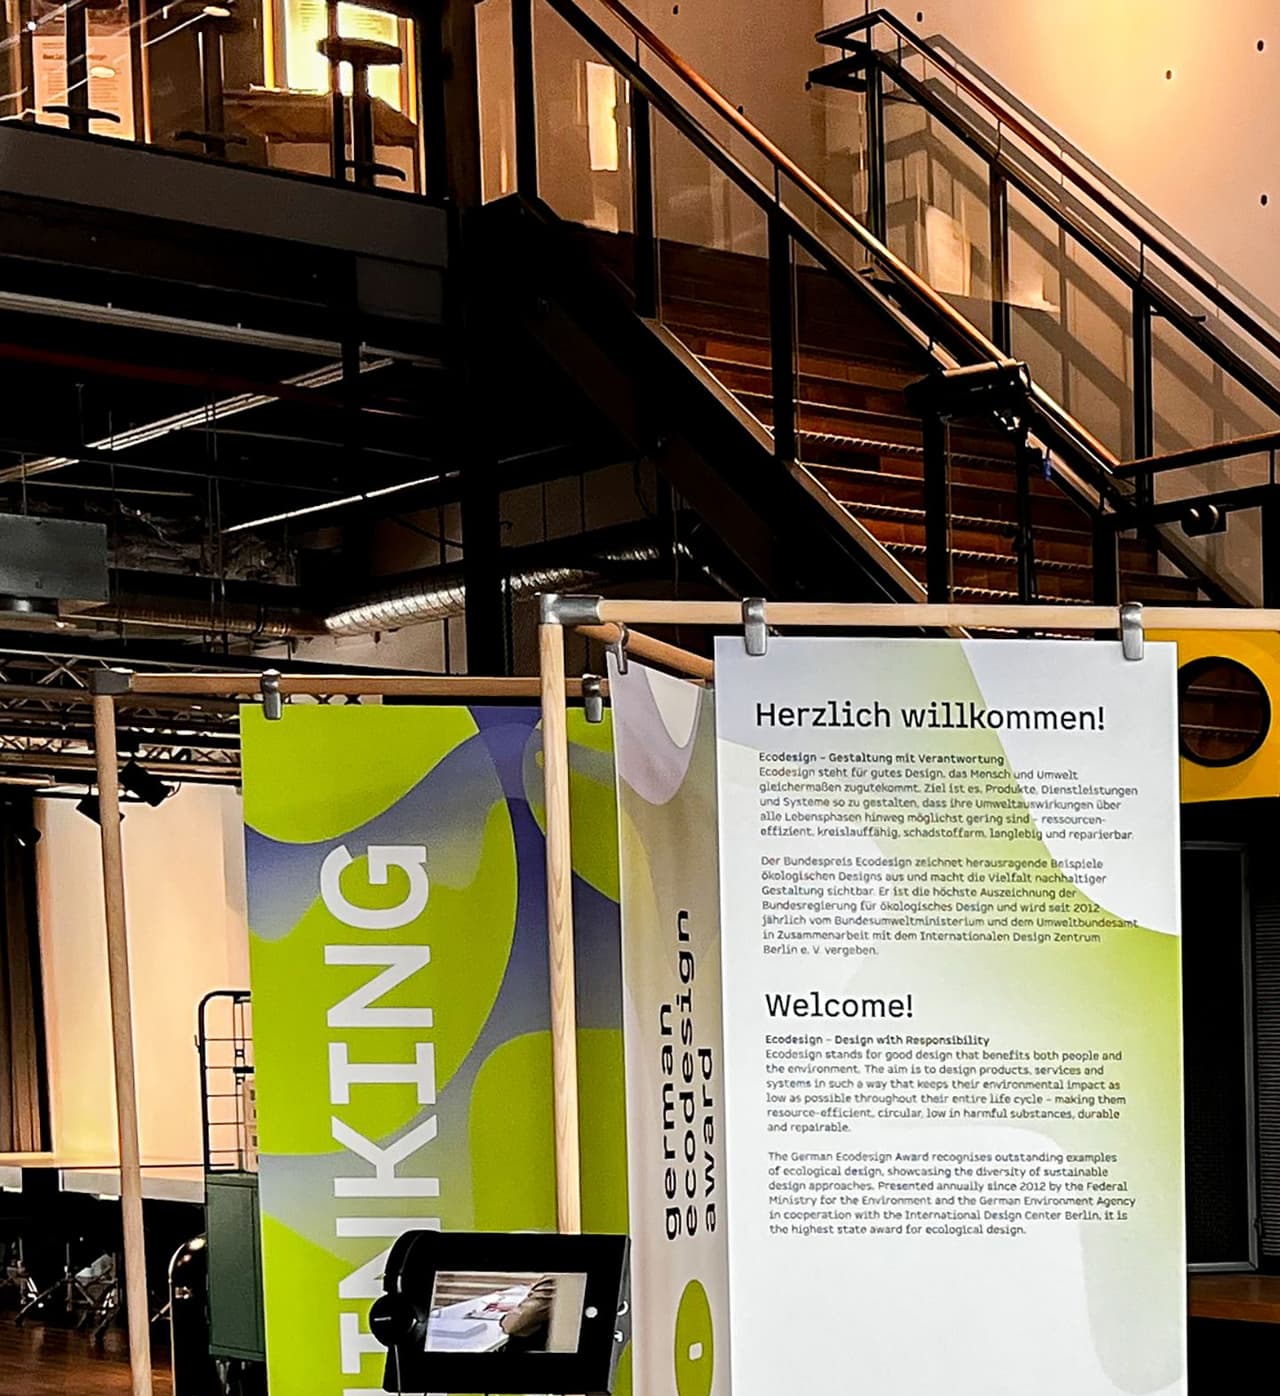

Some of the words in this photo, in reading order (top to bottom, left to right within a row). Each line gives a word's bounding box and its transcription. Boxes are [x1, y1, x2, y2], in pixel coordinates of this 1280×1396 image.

[756, 700, 890, 727] Herzlich
[901, 701, 1103, 730] willkommen!
[759, 751, 817, 765] Ecodesign
[895, 752, 915, 763] mit
[759, 767, 815, 781] Ecodesign
[817, 767, 848, 778] steht
[851, 767, 868, 778] für
[870, 768, 902, 781] gutes
[948, 768, 967, 779] das
[970, 768, 1011, 779] Mensch
[1012, 769, 1033, 779] und
[1036, 769, 1078, 780] Umwelt
[924, 783, 946, 793] Ziel
[949, 783, 965, 794] ist
[765, 991, 912, 1017] Welcome!
[765, 1033, 823, 1047] Ecodesign
[834, 1034, 873, 1047] Design
[876, 1034, 903, 1045] with
[765, 1049, 822, 1062] Ecodesign
[825, 1049, 863, 1060] stands
[865, 1049, 882, 1060] for
[885, 1049, 913, 1062] good
[915, 1049, 952, 1063] design
[955, 1049, 979, 1060] that
[982, 1049, 1030, 1060] benefits
[1033, 1050, 1059, 1060] both
[1061, 1050, 1099, 1063] people
[1101, 1050, 1122, 1061] and
[676, 910, 698, 1237] ecodesign
[765, 1063, 785, 1074] the
[864, 1064, 884, 1075] The
[887, 1064, 908, 1075] aim
[910, 1064, 921, 1075] is
[923, 1064, 936, 1075] to
[938, 1064, 976, 1078] design
[1034, 1065, 1081, 1075] services
[1083, 1065, 1104, 1076] and
[660, 1004, 681, 1241] german
[767, 1121, 787, 1132] and
[698, 1048, 716, 1233] award
[768, 1150, 788, 1161] The
[790, 1151, 832, 1161] German
[835, 1151, 892, 1164] Ecodesign
[894, 1151, 929, 1162] Award
[1065, 1152, 1117, 1165] examples
[768, 1180, 806, 1193] design
[877, 1180, 934, 1191] Presented
[936, 1180, 984, 1194] annually
[987, 1180, 1017, 1191] since
[1019, 1181, 1046, 1191] 2012
[1048, 1181, 1062, 1194] by
[1064, 1181, 1083, 1191] the
[1086, 1181, 1128, 1192] Federal
